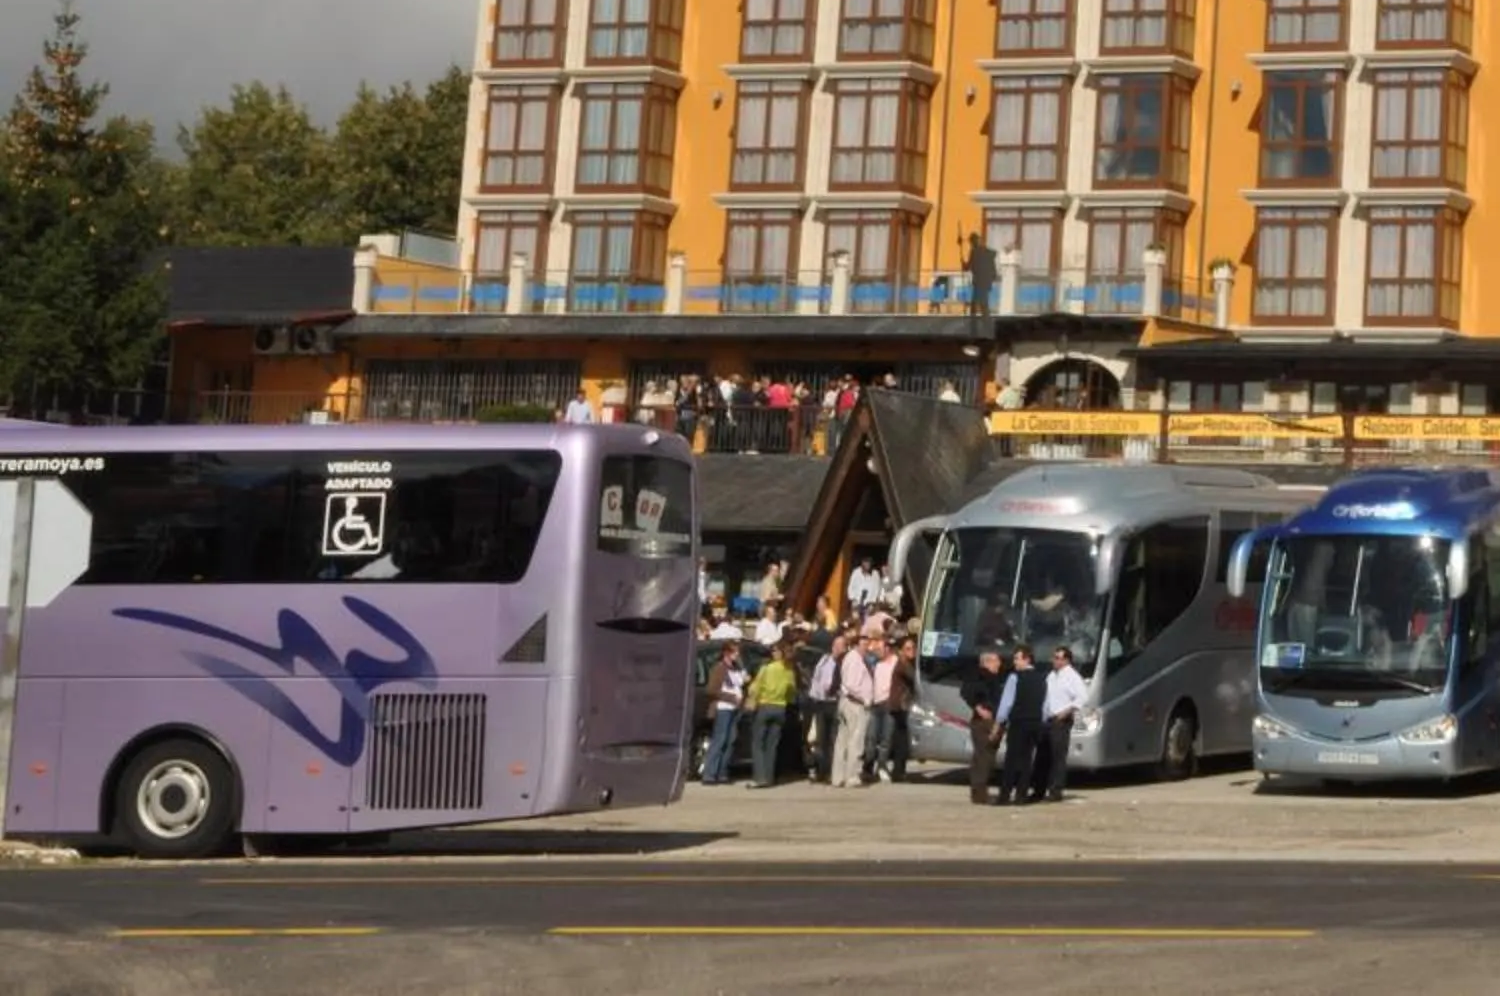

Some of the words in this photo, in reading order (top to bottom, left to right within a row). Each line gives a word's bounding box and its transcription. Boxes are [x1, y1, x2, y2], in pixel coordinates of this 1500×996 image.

[0, 457, 104, 475] reramoya.es
[327, 460, 392, 473] VEHÍCULO
[324, 478, 393, 490] ADAPTADO
